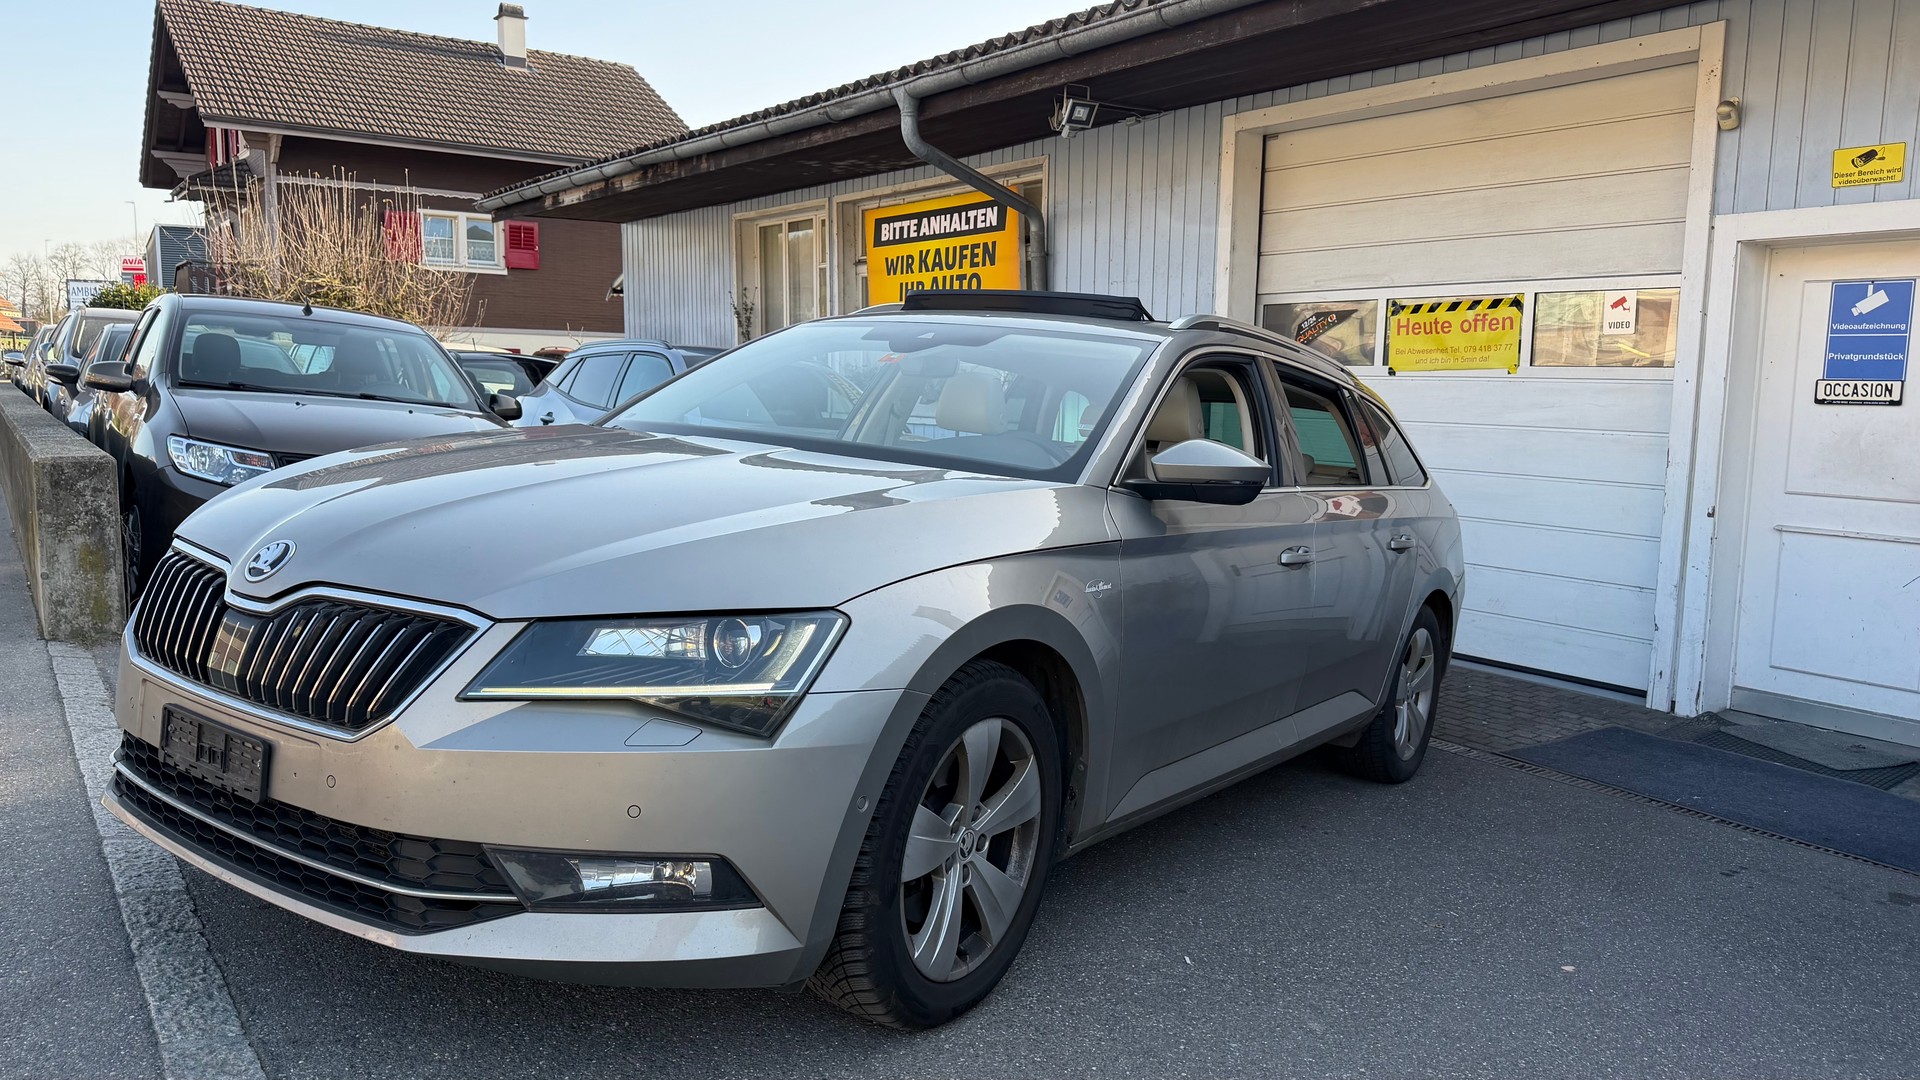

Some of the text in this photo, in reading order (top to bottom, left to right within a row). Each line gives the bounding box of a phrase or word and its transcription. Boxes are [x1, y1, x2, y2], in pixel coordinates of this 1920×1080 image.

[1857, 168, 1885, 177] Bereich
[1838, 174, 1896, 185] videoüberwacht!
[881, 206, 999, 242] BITTE ANHALTEN
[122, 257, 144, 265] AVIA
[885, 240, 997, 277] WIR KAUFEN
[930, 272, 982, 291] AUTO
[1396, 312, 1514, 336] Heute offen
[1608, 320, 1631, 329] VIDEO
[1832, 322, 1906, 331] Videoaufzeichnung
[1395, 343, 1513, 355] Bei Abwesenheit Tel. 079 418 37 77
[1429, 356, 1440, 364] ich
[1460, 355, 1478, 363] 5min
[1478, 354, 1490, 362] da!
[1828, 352, 1904, 362] Privatgrundstück
[1824, 383, 1893, 398] OCCASION
